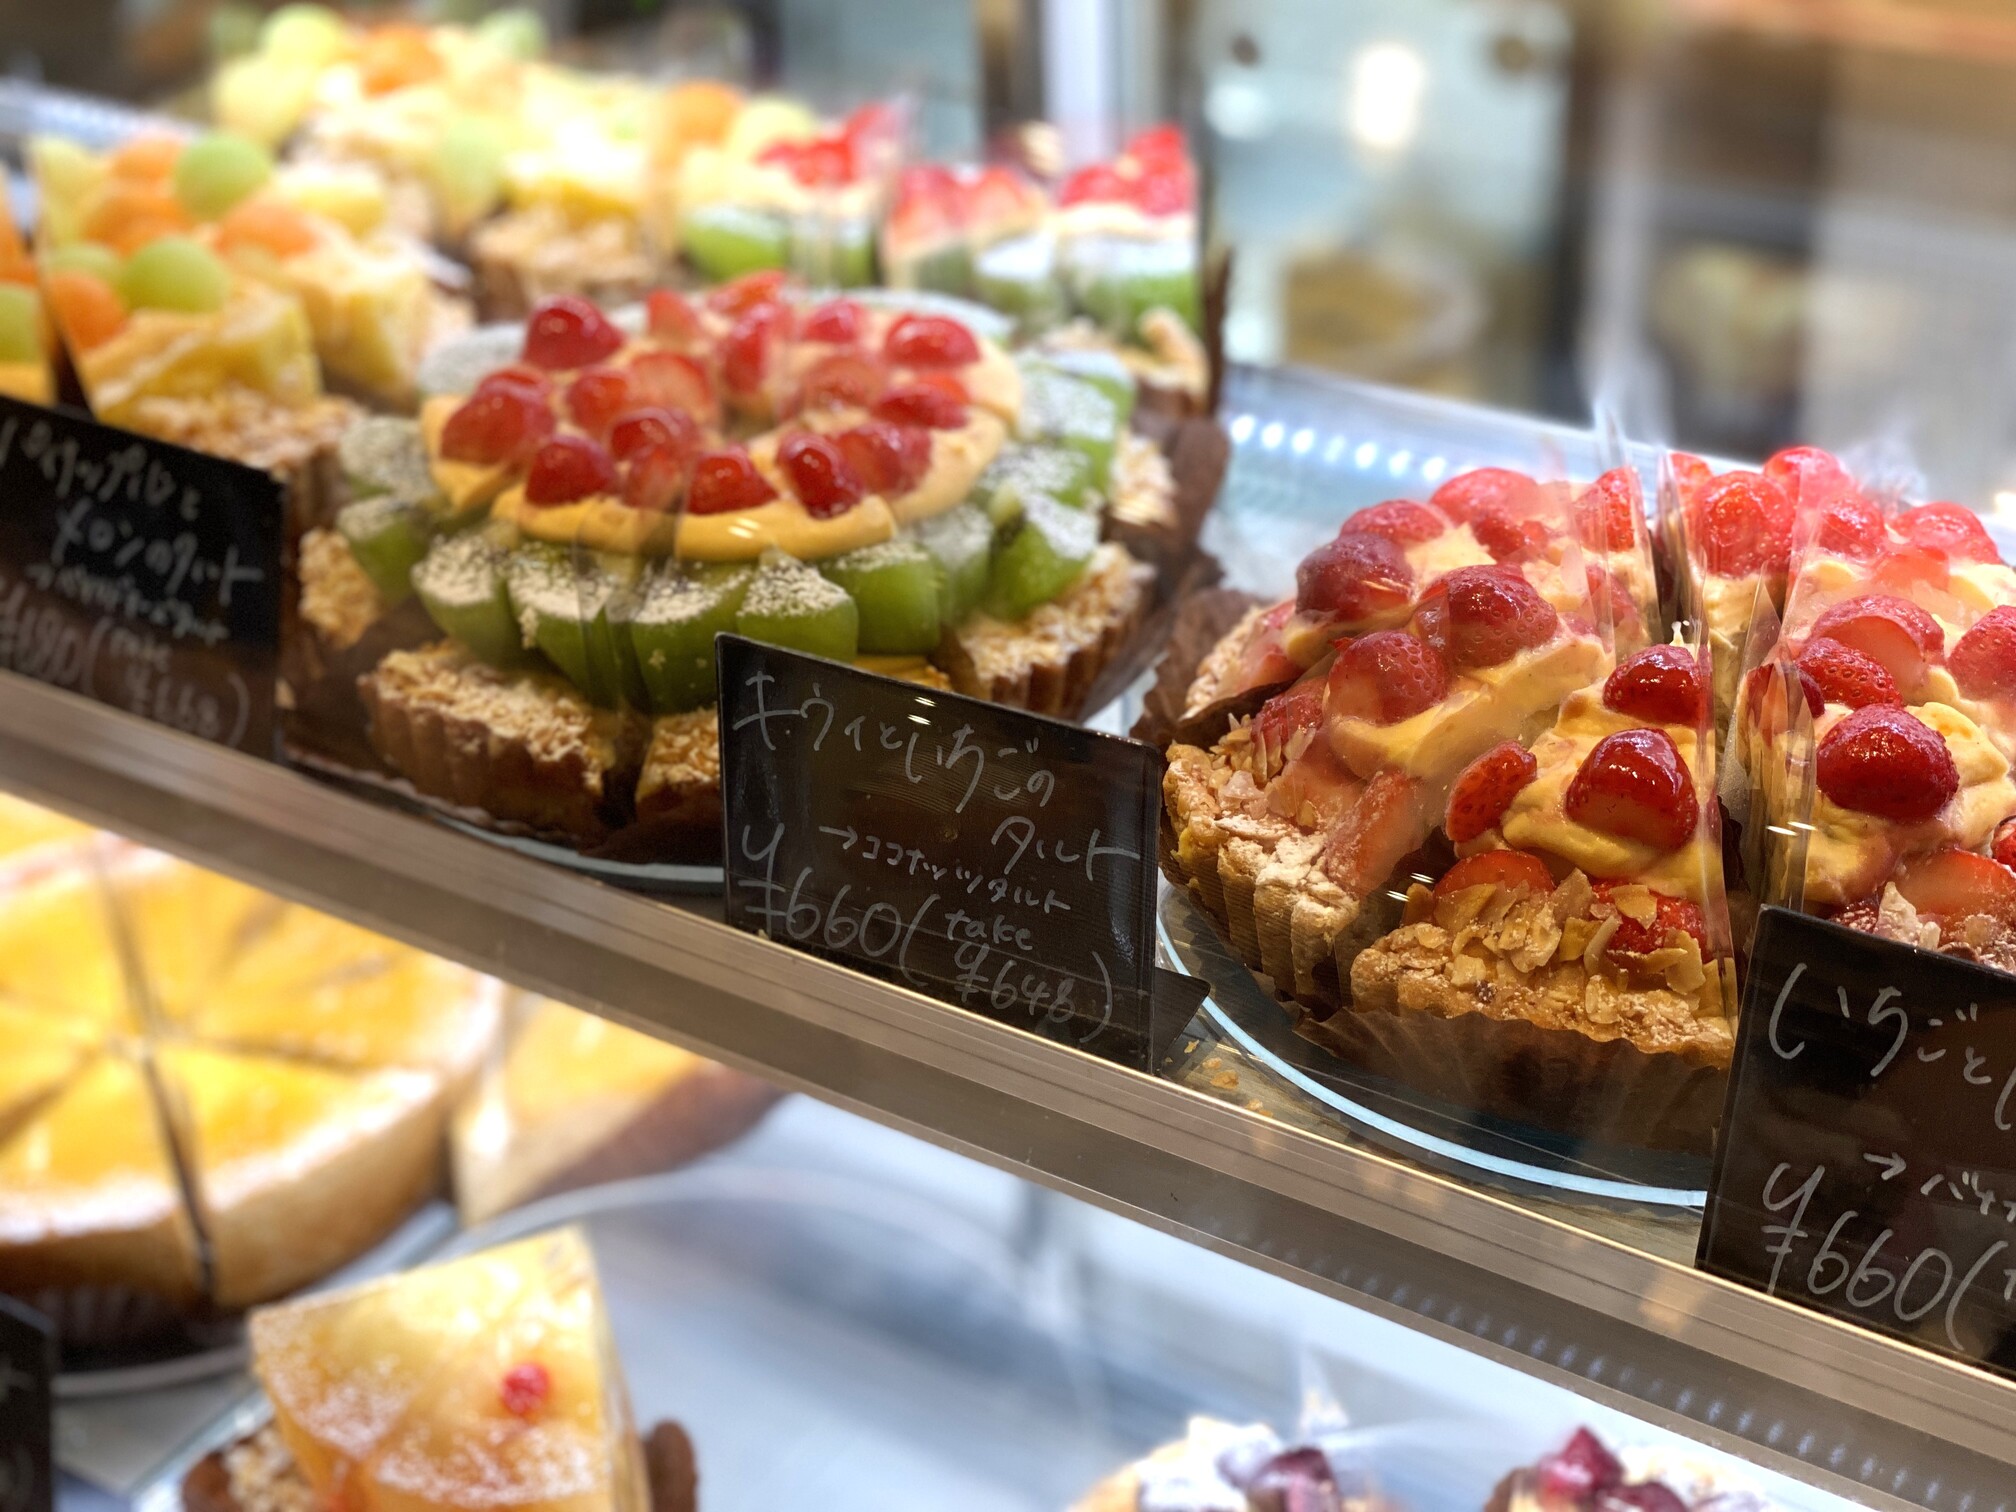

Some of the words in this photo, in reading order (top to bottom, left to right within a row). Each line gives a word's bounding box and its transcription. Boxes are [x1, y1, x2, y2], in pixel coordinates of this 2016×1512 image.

[990, 815, 1141, 881] タルト
[944, 908, 1034, 951] take
